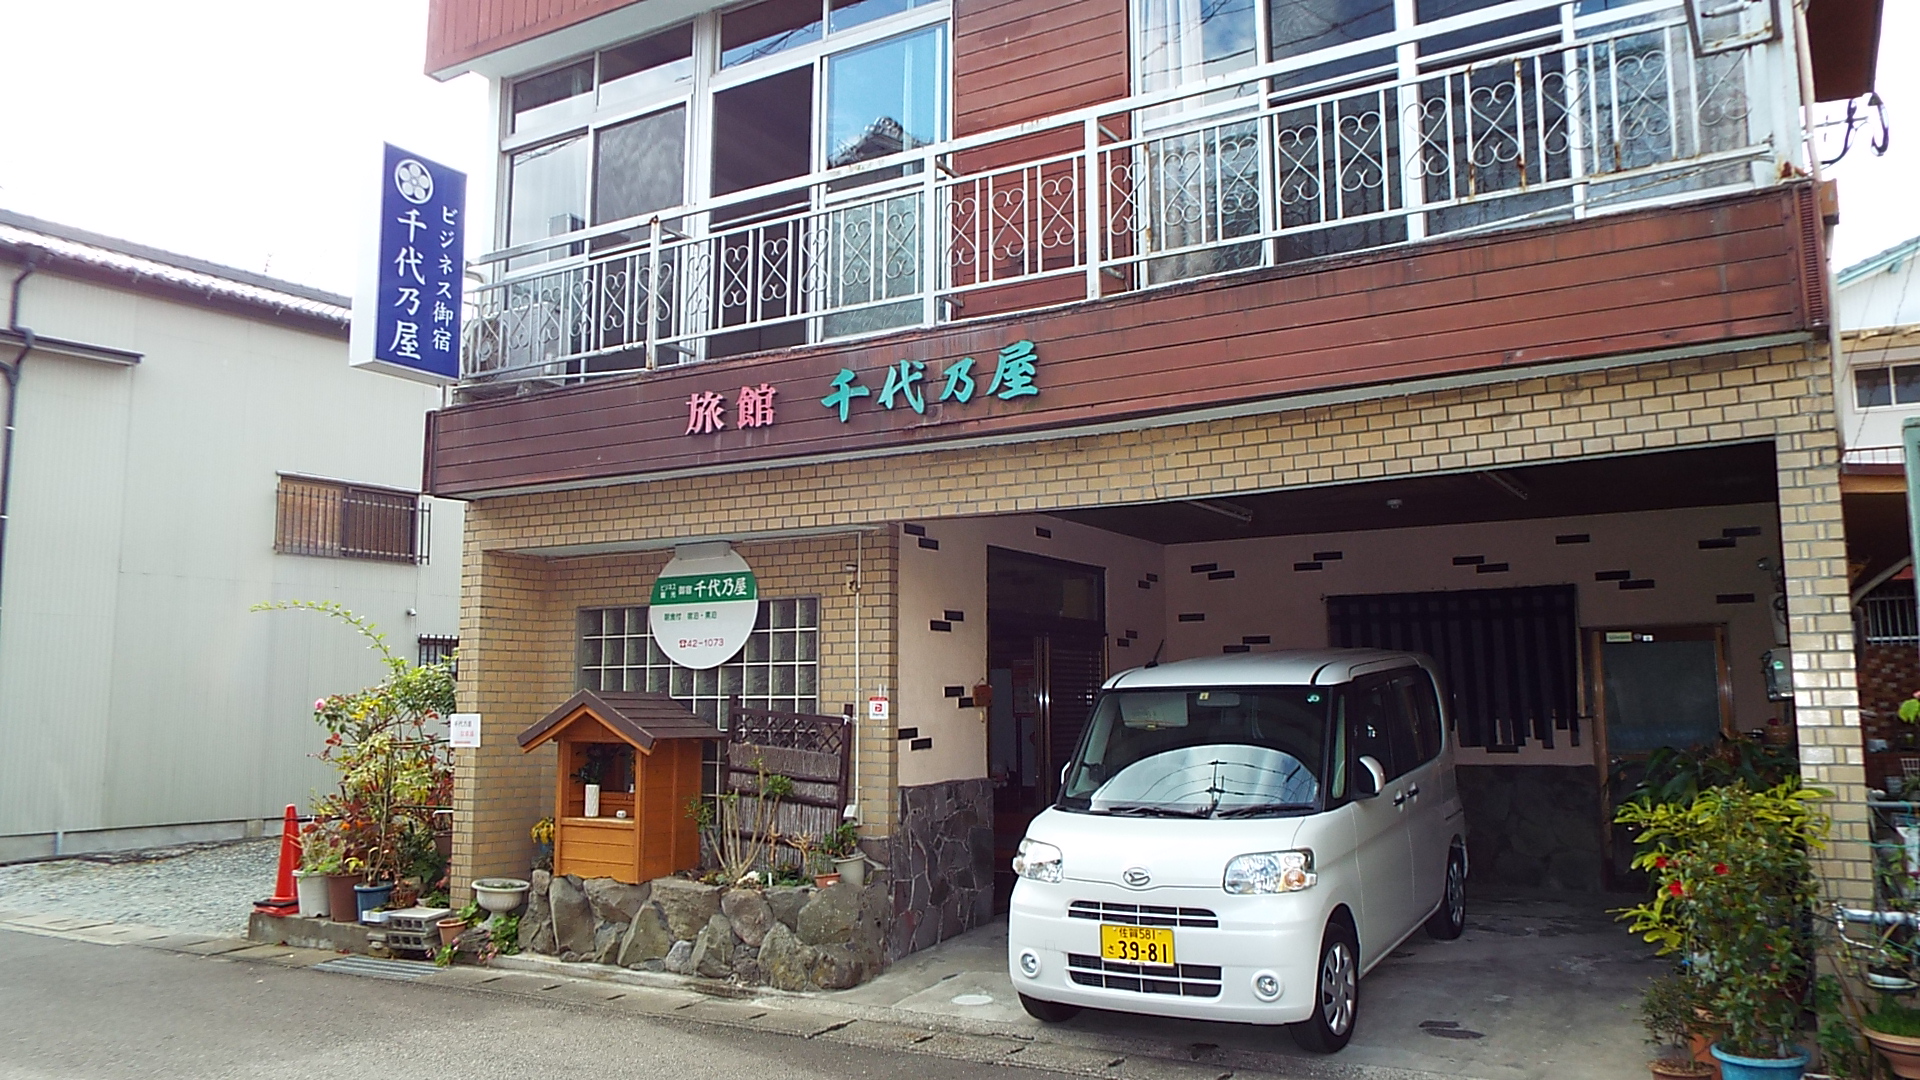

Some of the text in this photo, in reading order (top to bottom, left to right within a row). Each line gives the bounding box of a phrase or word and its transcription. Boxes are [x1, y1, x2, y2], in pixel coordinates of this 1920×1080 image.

[389, 208, 427, 361] 千代乃屋
[432, 205, 458, 353] ビジネス御宿
[685, 340, 1040, 436] 旅館 千代乃屋
[694, 577, 747, 598] 千代乃屋
[687, 638, 724, 648] 42-1073
[1119, 928, 1155, 939] 佐賀581
[1107, 940, 1167, 963] さ 39-81
